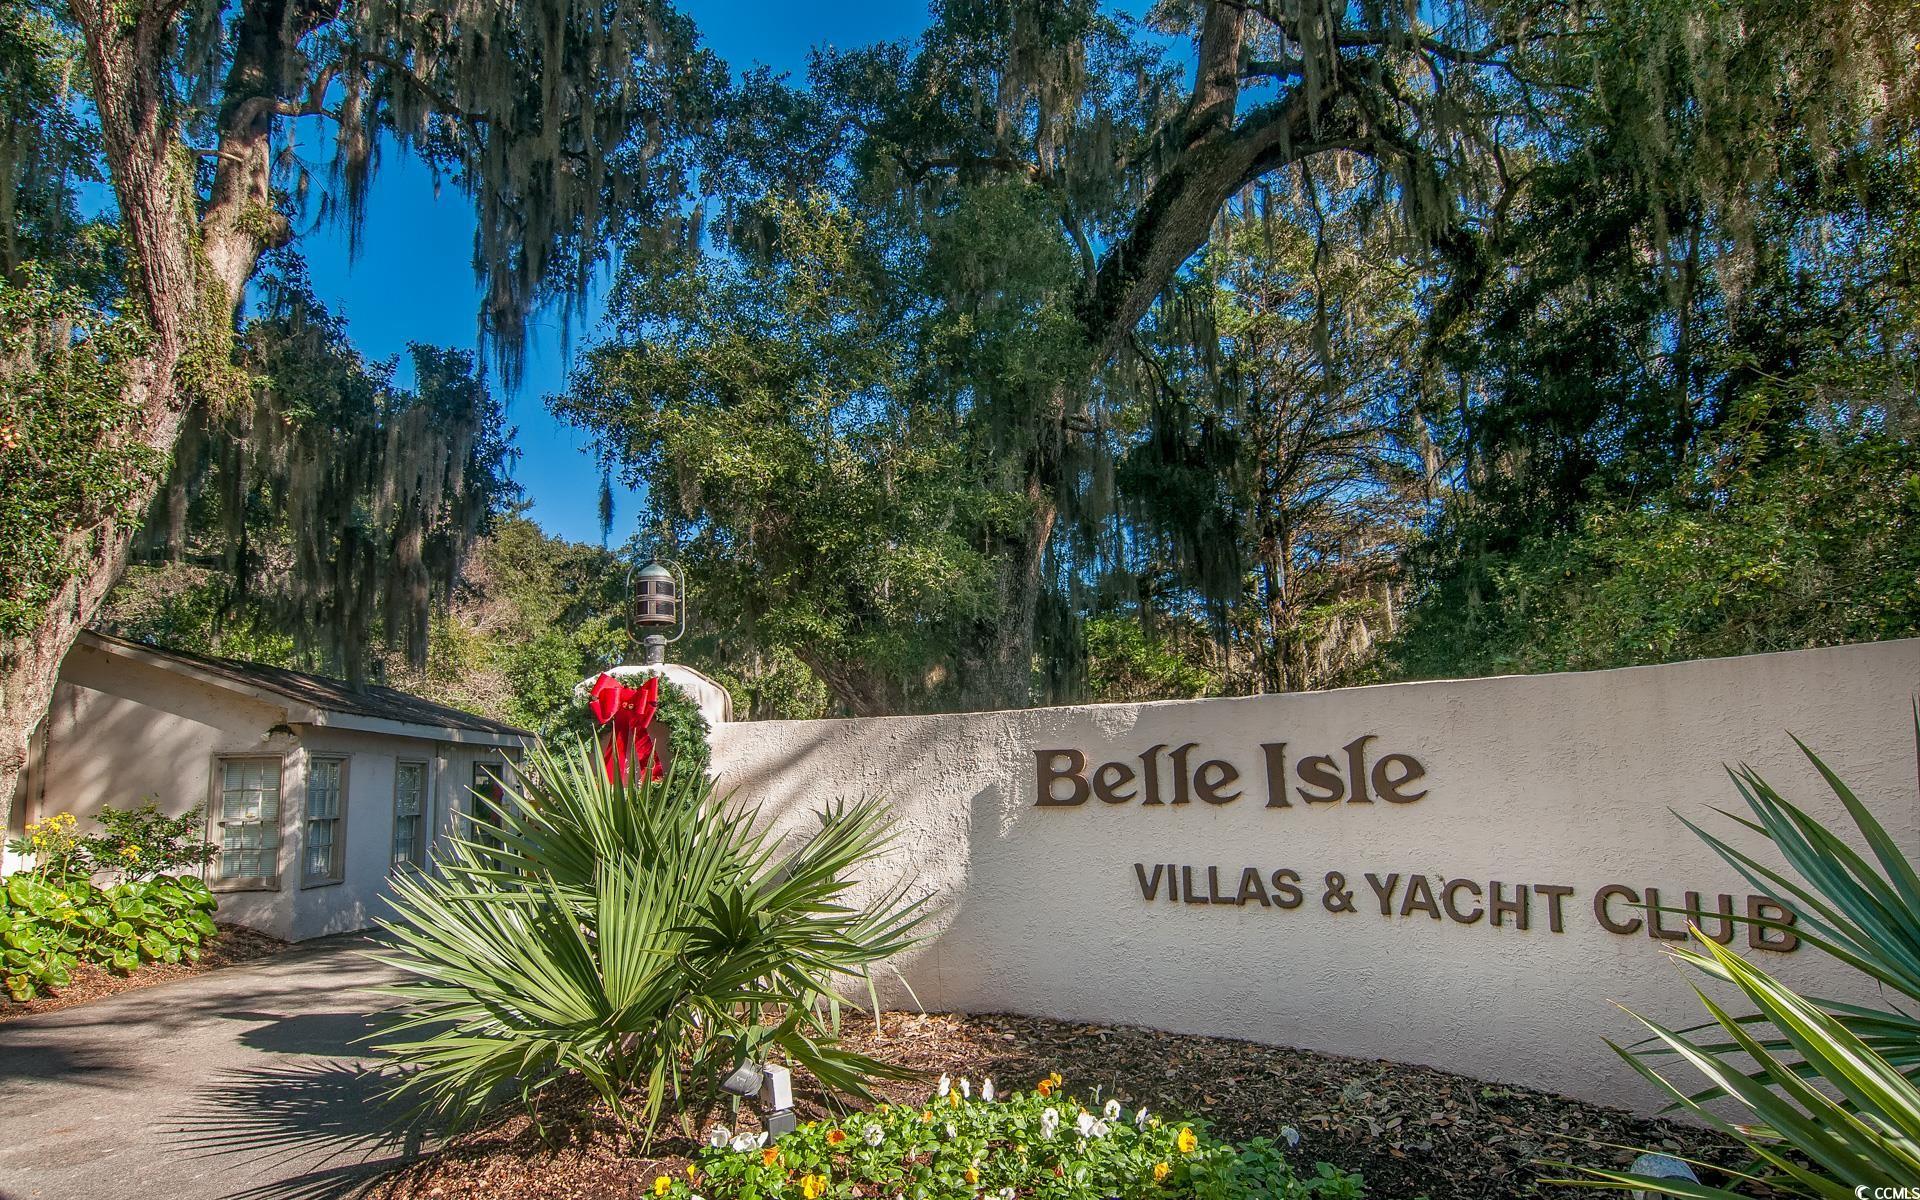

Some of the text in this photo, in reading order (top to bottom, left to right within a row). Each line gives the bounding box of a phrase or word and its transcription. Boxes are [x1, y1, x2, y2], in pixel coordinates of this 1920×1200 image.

[1034, 734, 1428, 808] Belle Isle
[1134, 863, 1799, 953] VILLAS & YACHT CLUB
